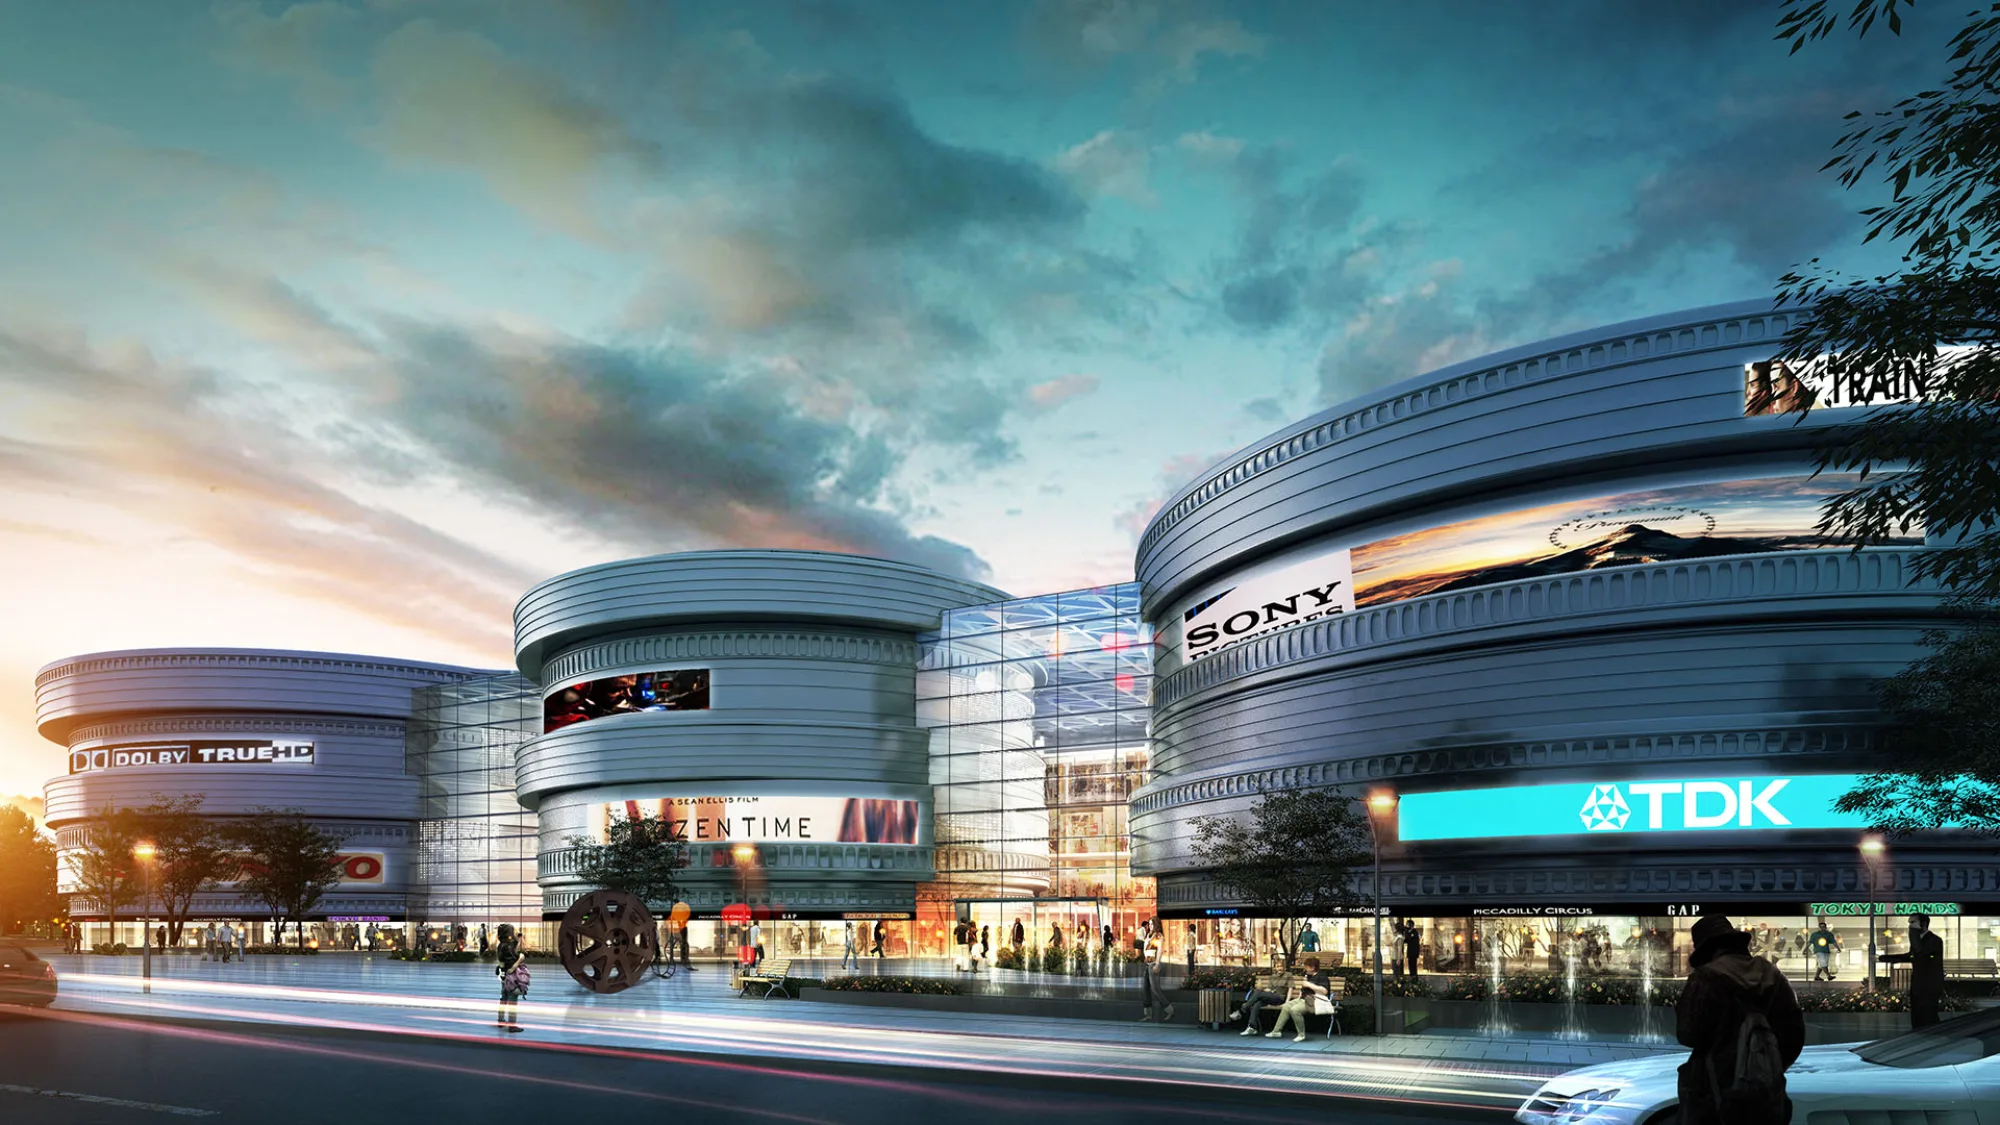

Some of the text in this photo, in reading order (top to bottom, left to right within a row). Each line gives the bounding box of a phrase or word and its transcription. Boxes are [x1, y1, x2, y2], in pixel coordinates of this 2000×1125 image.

[1186, 581, 1342, 650] SONY
[116, 744, 313, 766] DOLBY TRUEHD
[678, 798, 704, 806] SEAN
[706, 797, 734, 805] ELLIS
[736, 796, 759, 804] FILM
[1629, 779, 1792, 829] TDK
[675, 816, 811, 839] ZEN TIME
[1473, 907, 1593, 916] PICCADILLY CIRCUS
[1667, 904, 1700, 916] GAP
[1810, 902, 1959, 916] TOKYU HANDS
